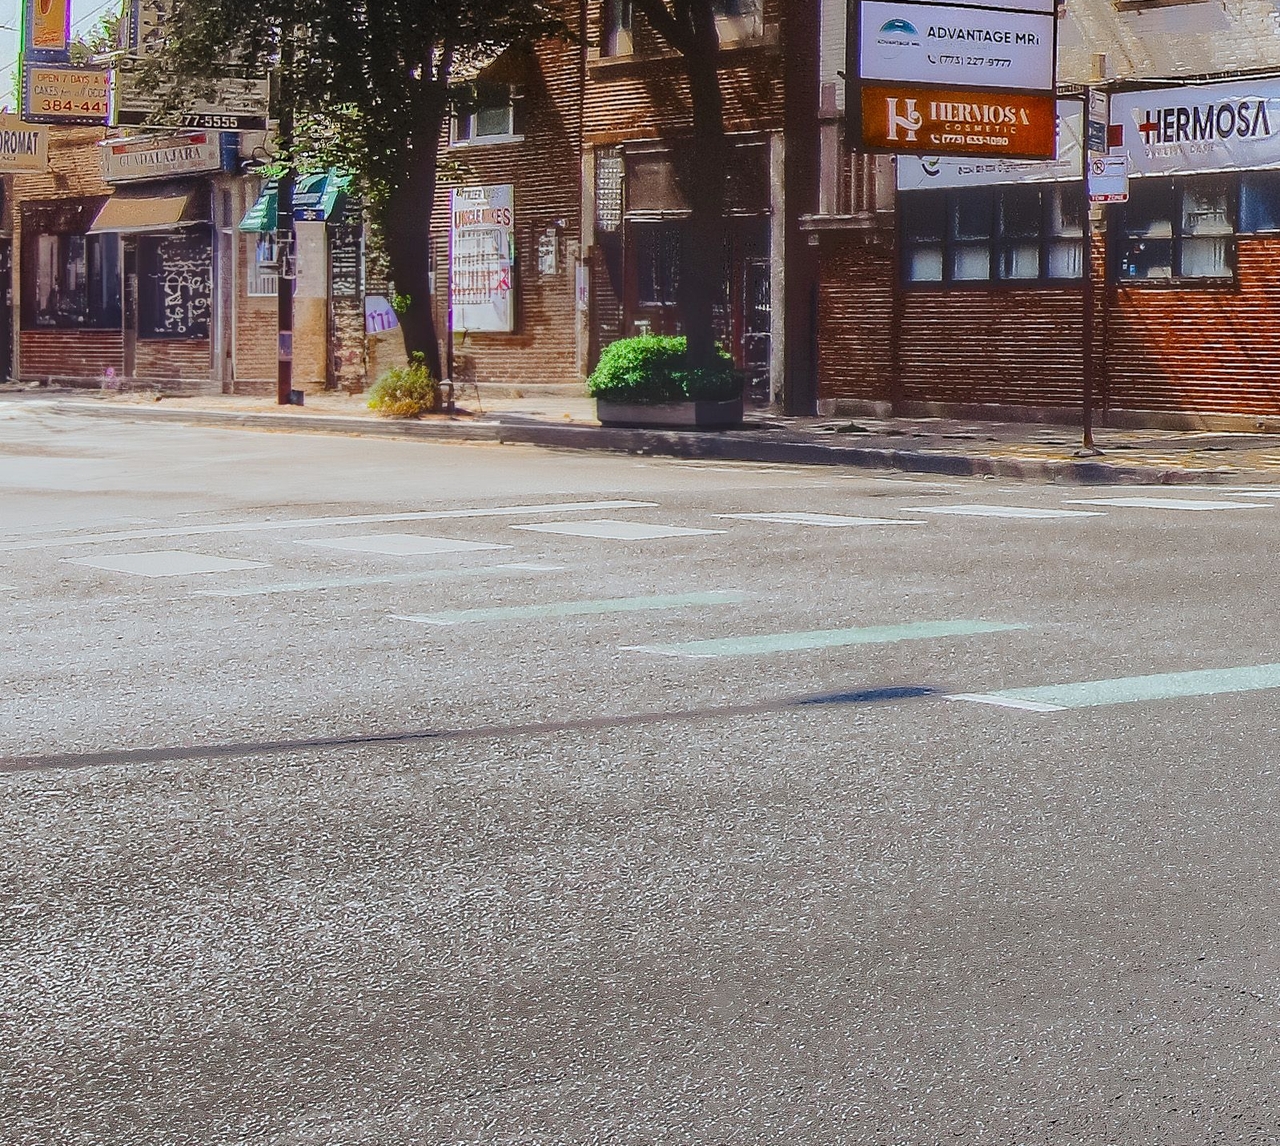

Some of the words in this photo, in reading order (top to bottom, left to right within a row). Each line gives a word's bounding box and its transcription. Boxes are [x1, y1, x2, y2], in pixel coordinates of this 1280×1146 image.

[927, 26, 1011, 44] ADVANTAGE
[37, 73, 59, 83] OPEN
[62, 74, 68, 83] 7
[70, 74, 89, 84] DAYS
[182, 115, 238, 128] 77-5555
[930, 101, 1030, 125] HERMOSA
[944, 123, 1017, 134] COSMETIC
[1138, 100, 1271, 145] HERMOSA
[119, 146, 202, 167] GUADALAJARA
